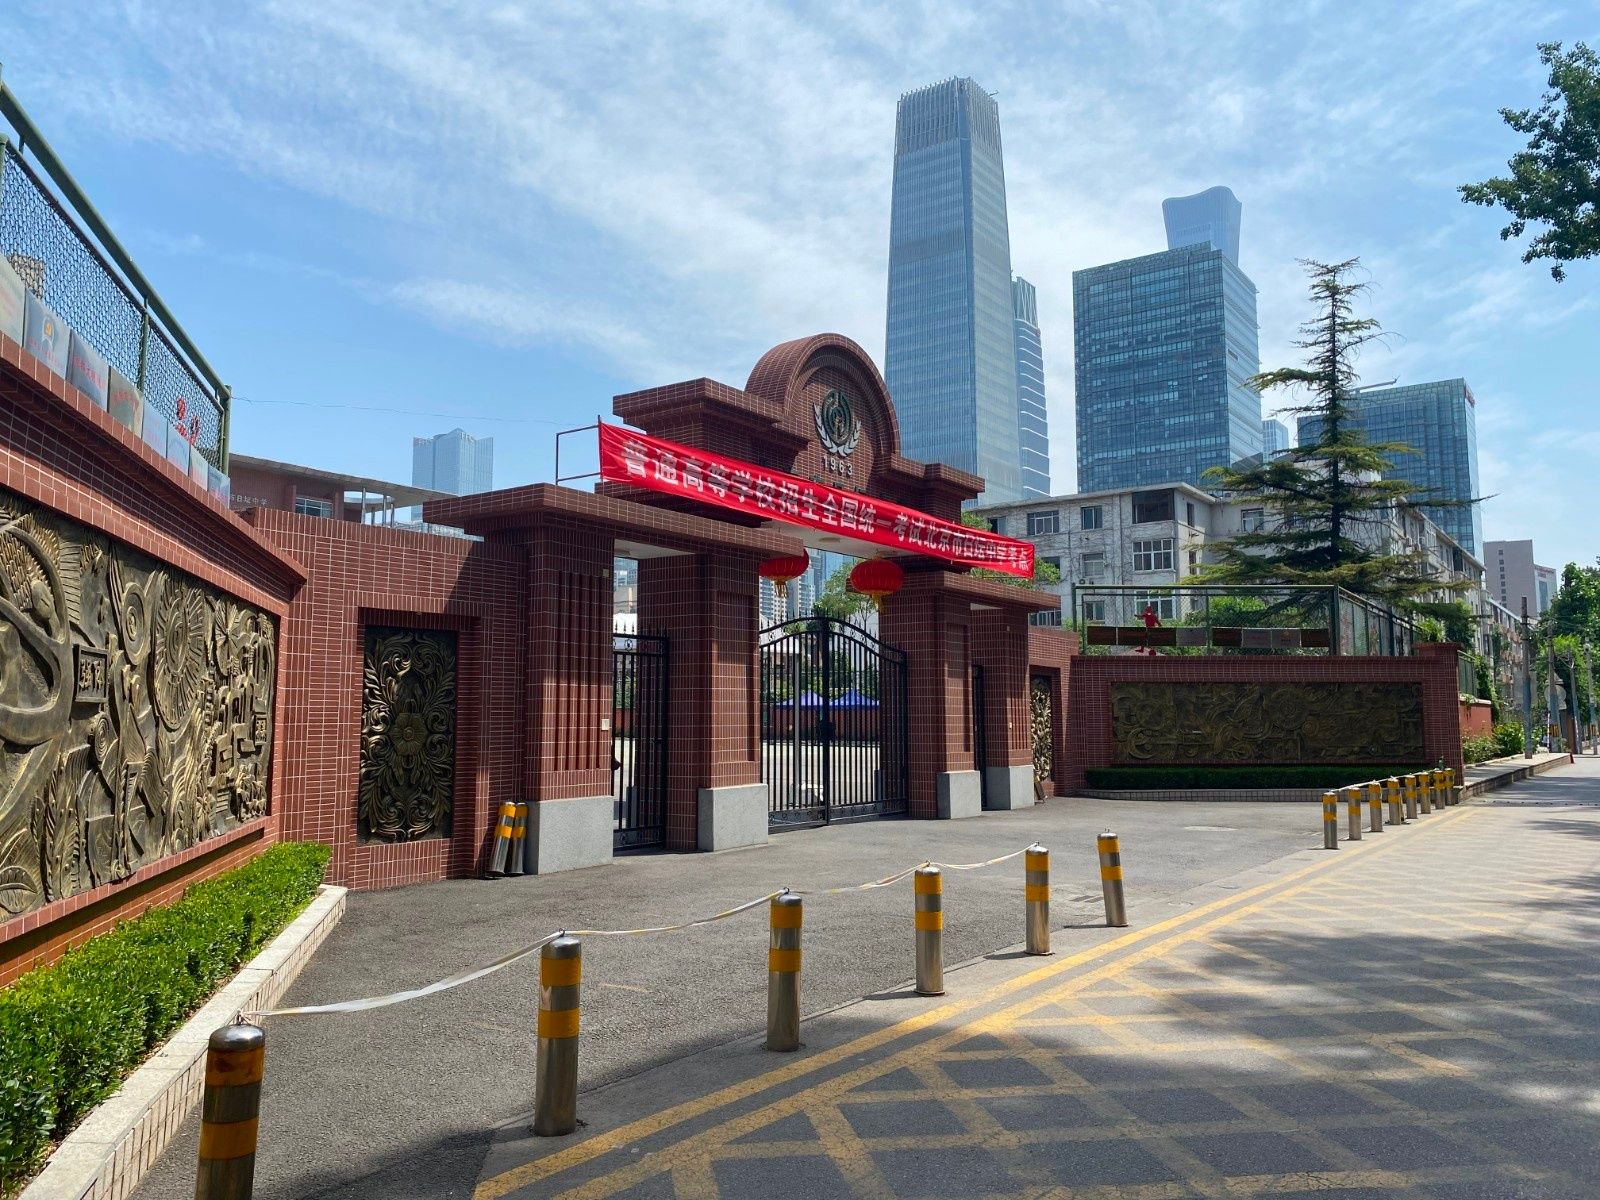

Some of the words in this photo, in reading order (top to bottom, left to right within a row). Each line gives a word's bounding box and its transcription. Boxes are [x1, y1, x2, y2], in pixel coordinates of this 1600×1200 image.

[823, 455, 853, 475] 1963
[620, 438, 1028, 571] 普通高等学校招生全国统一考试北京市日坛中学考点
